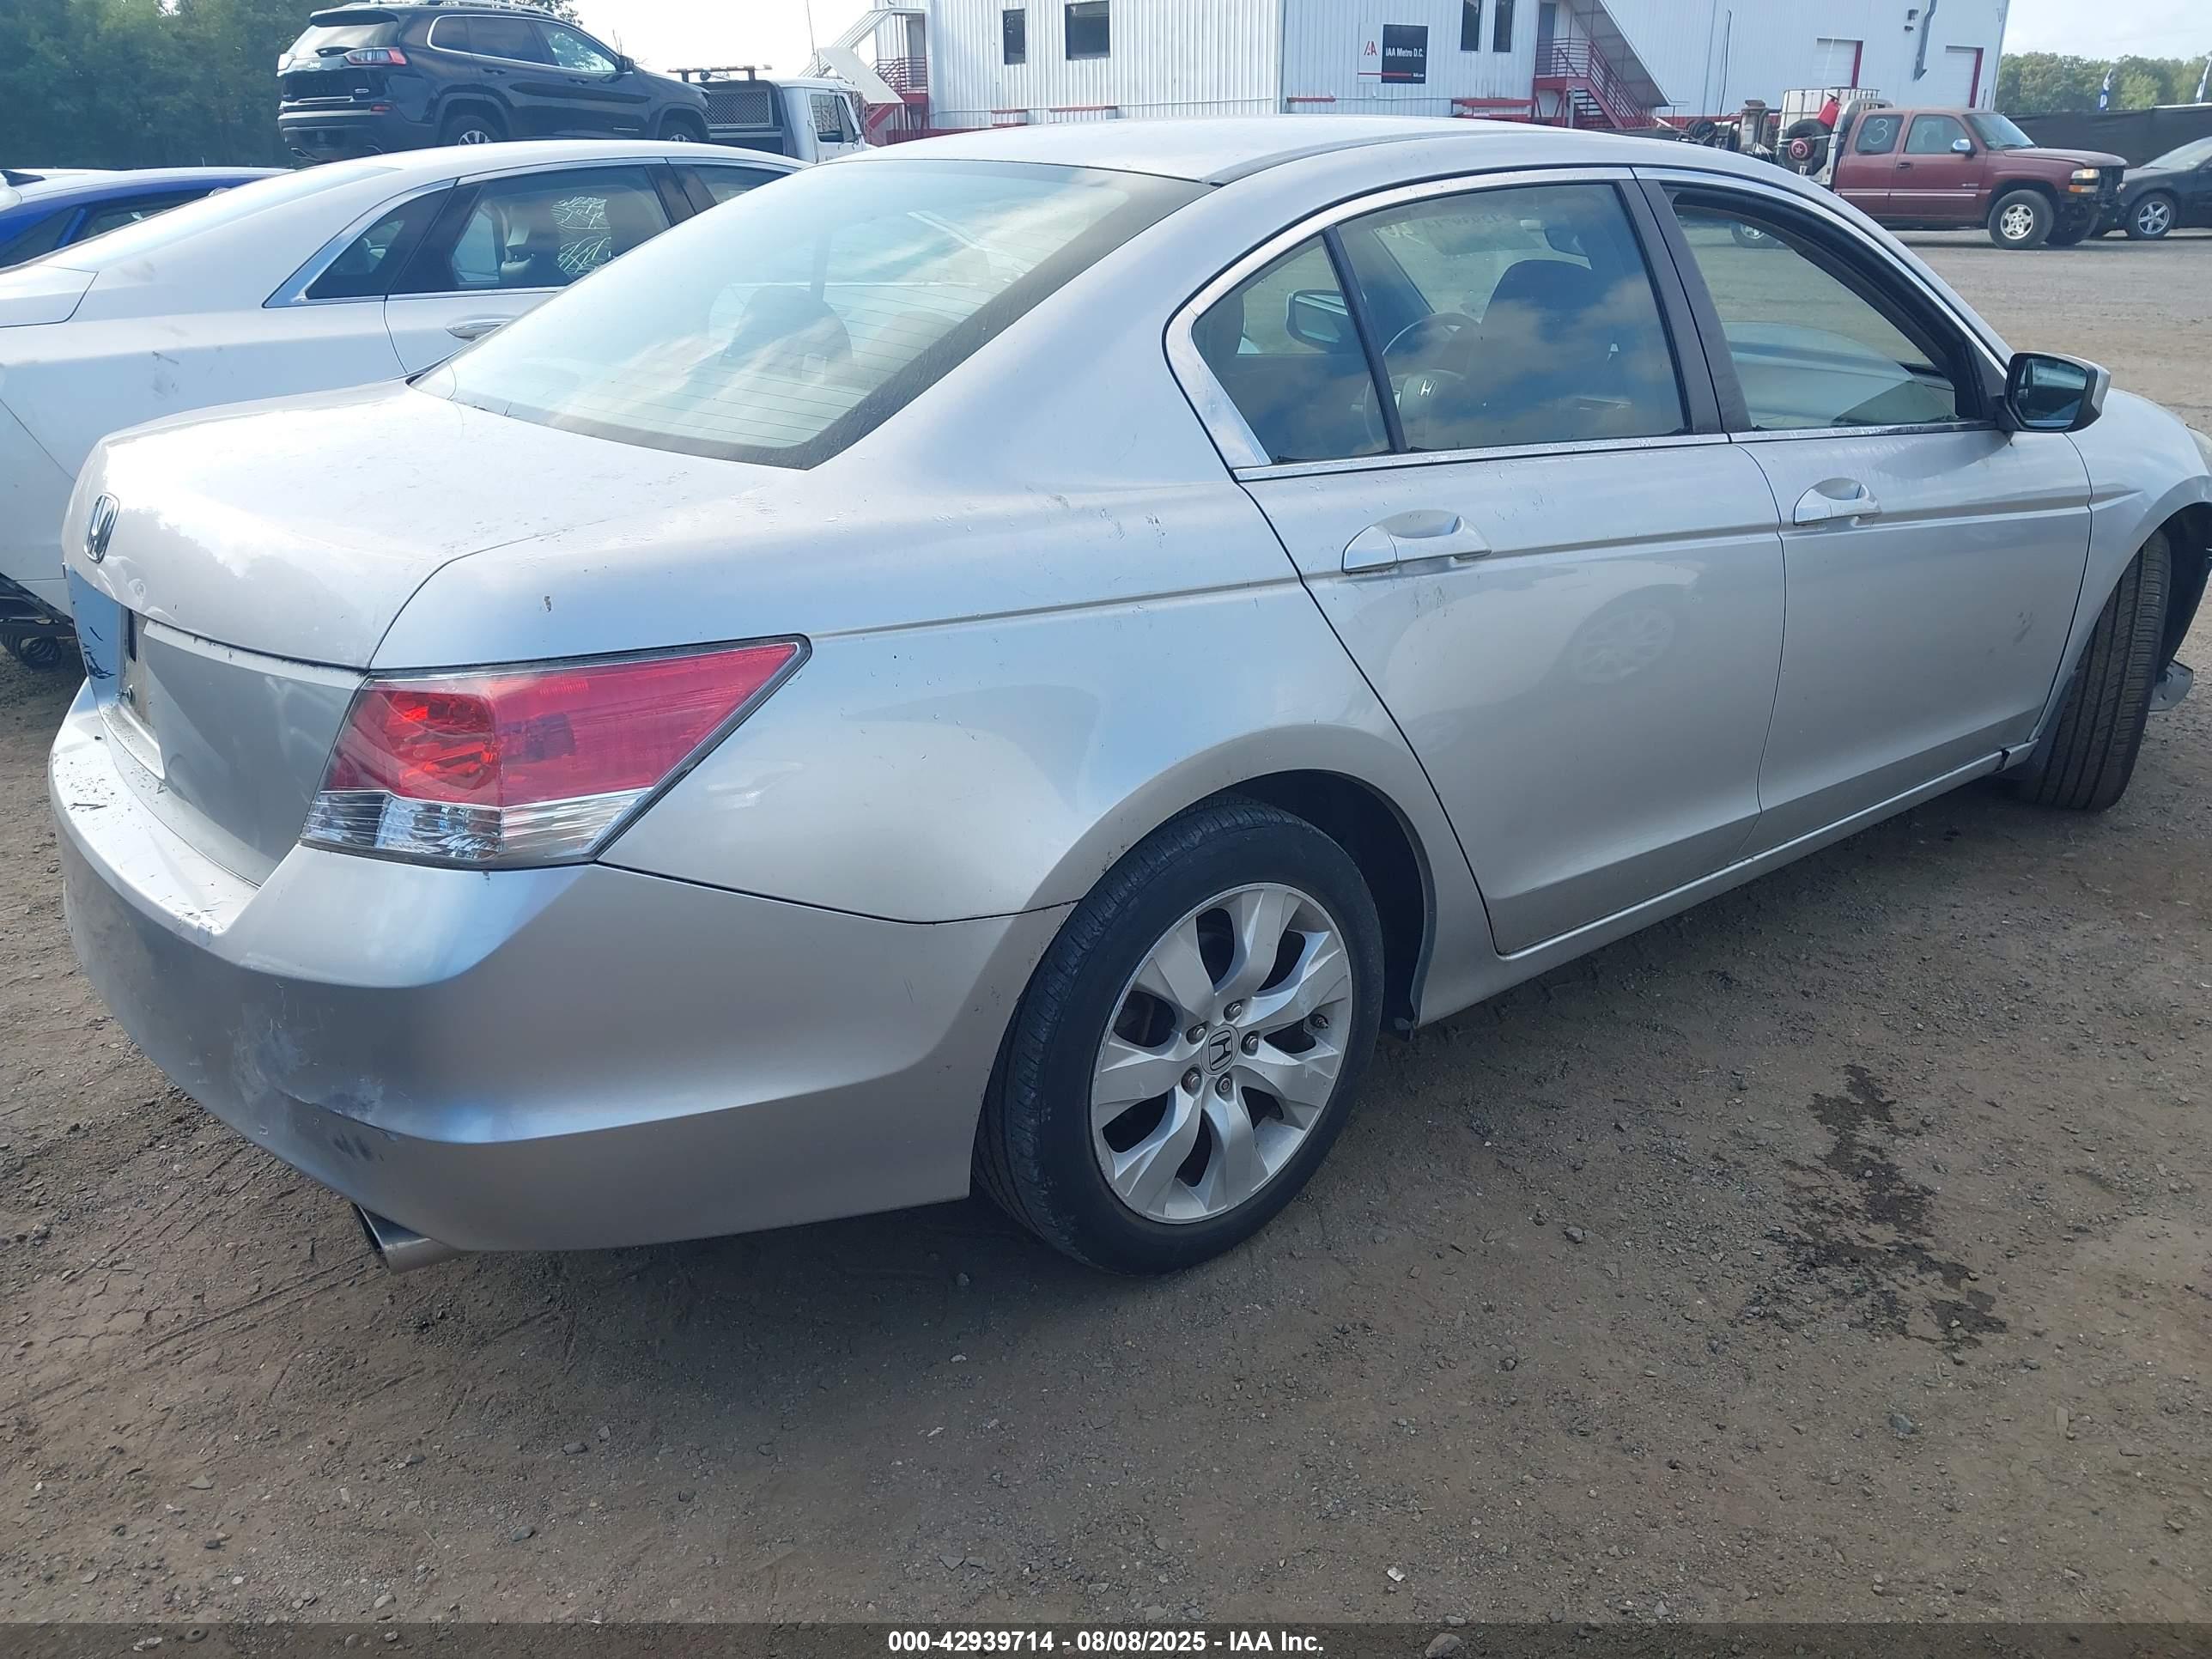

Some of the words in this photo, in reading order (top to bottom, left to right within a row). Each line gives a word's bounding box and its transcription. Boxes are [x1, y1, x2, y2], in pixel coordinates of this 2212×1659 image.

[1385, 47, 1396, 57] IAA
[1396, 47, 1413, 58] Metro
[1413, 48, 1424, 58] D.C.
[1869, 118, 1888, 144] 3
